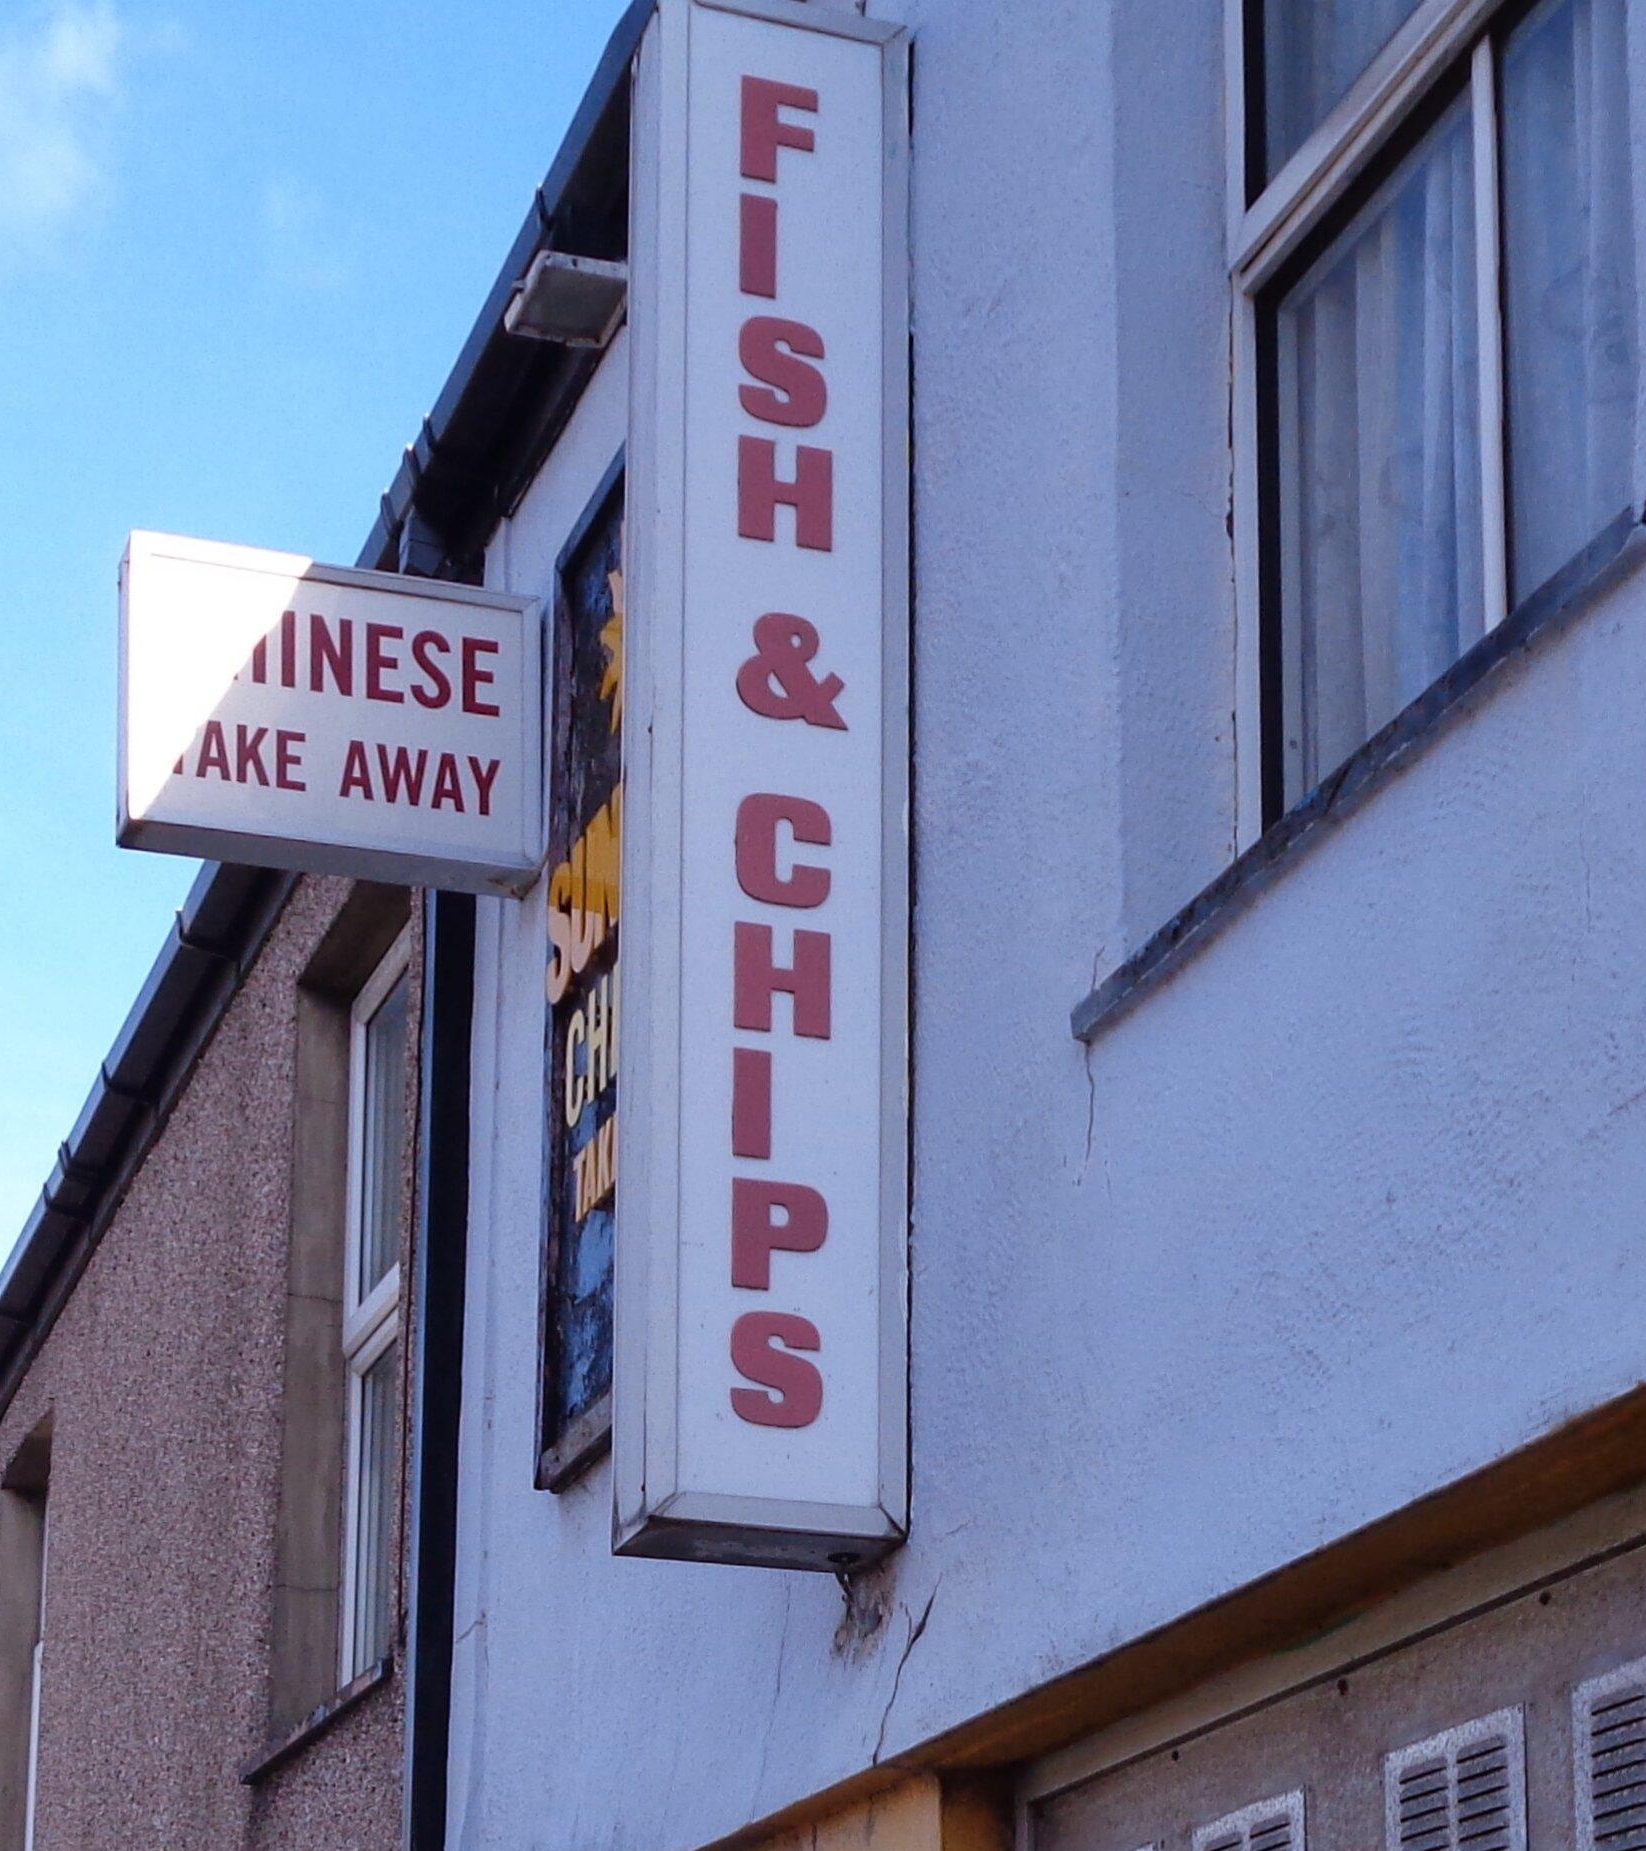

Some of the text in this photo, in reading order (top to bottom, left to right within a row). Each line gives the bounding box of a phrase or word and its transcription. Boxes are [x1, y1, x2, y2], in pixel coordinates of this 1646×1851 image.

[233, 611, 501, 718] INESE
[172, 719, 501, 817] AKE AWAY
[729, 74, 849, 1429] FISH & CHIPS
